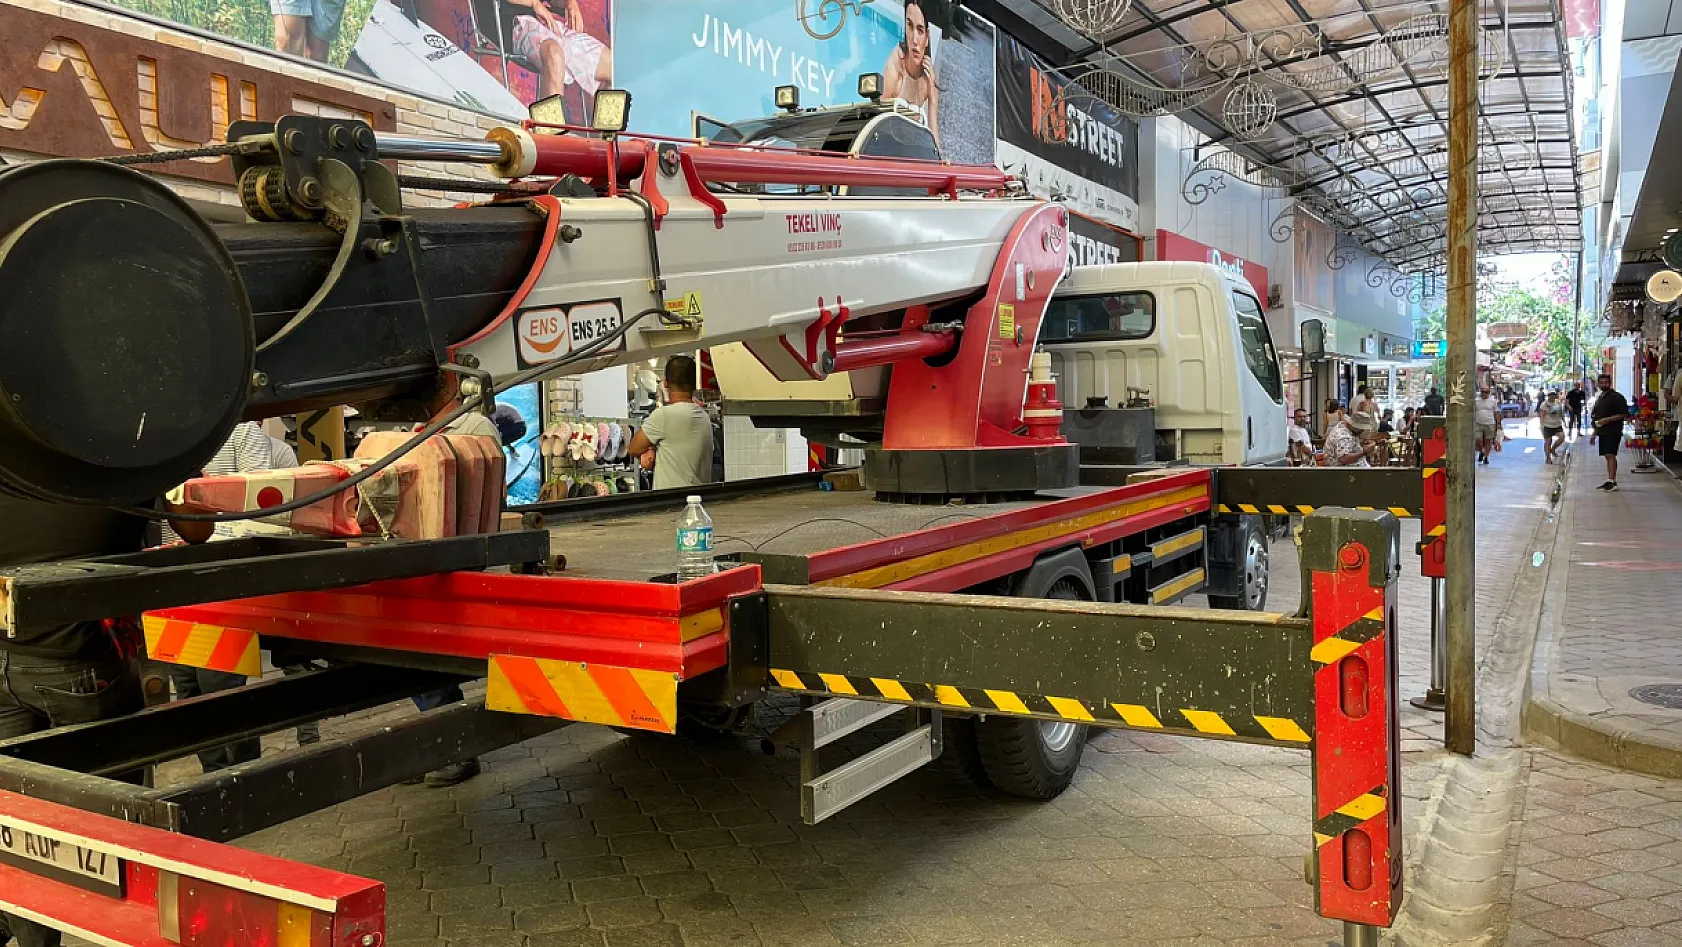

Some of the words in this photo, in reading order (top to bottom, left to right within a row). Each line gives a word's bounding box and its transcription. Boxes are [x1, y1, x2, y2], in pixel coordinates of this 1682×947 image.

[692, 13, 782, 77] JIMMY
[792, 51, 835, 98] KEY
[530, 317, 558, 337] ENS
[571, 319, 594, 341] ENS
